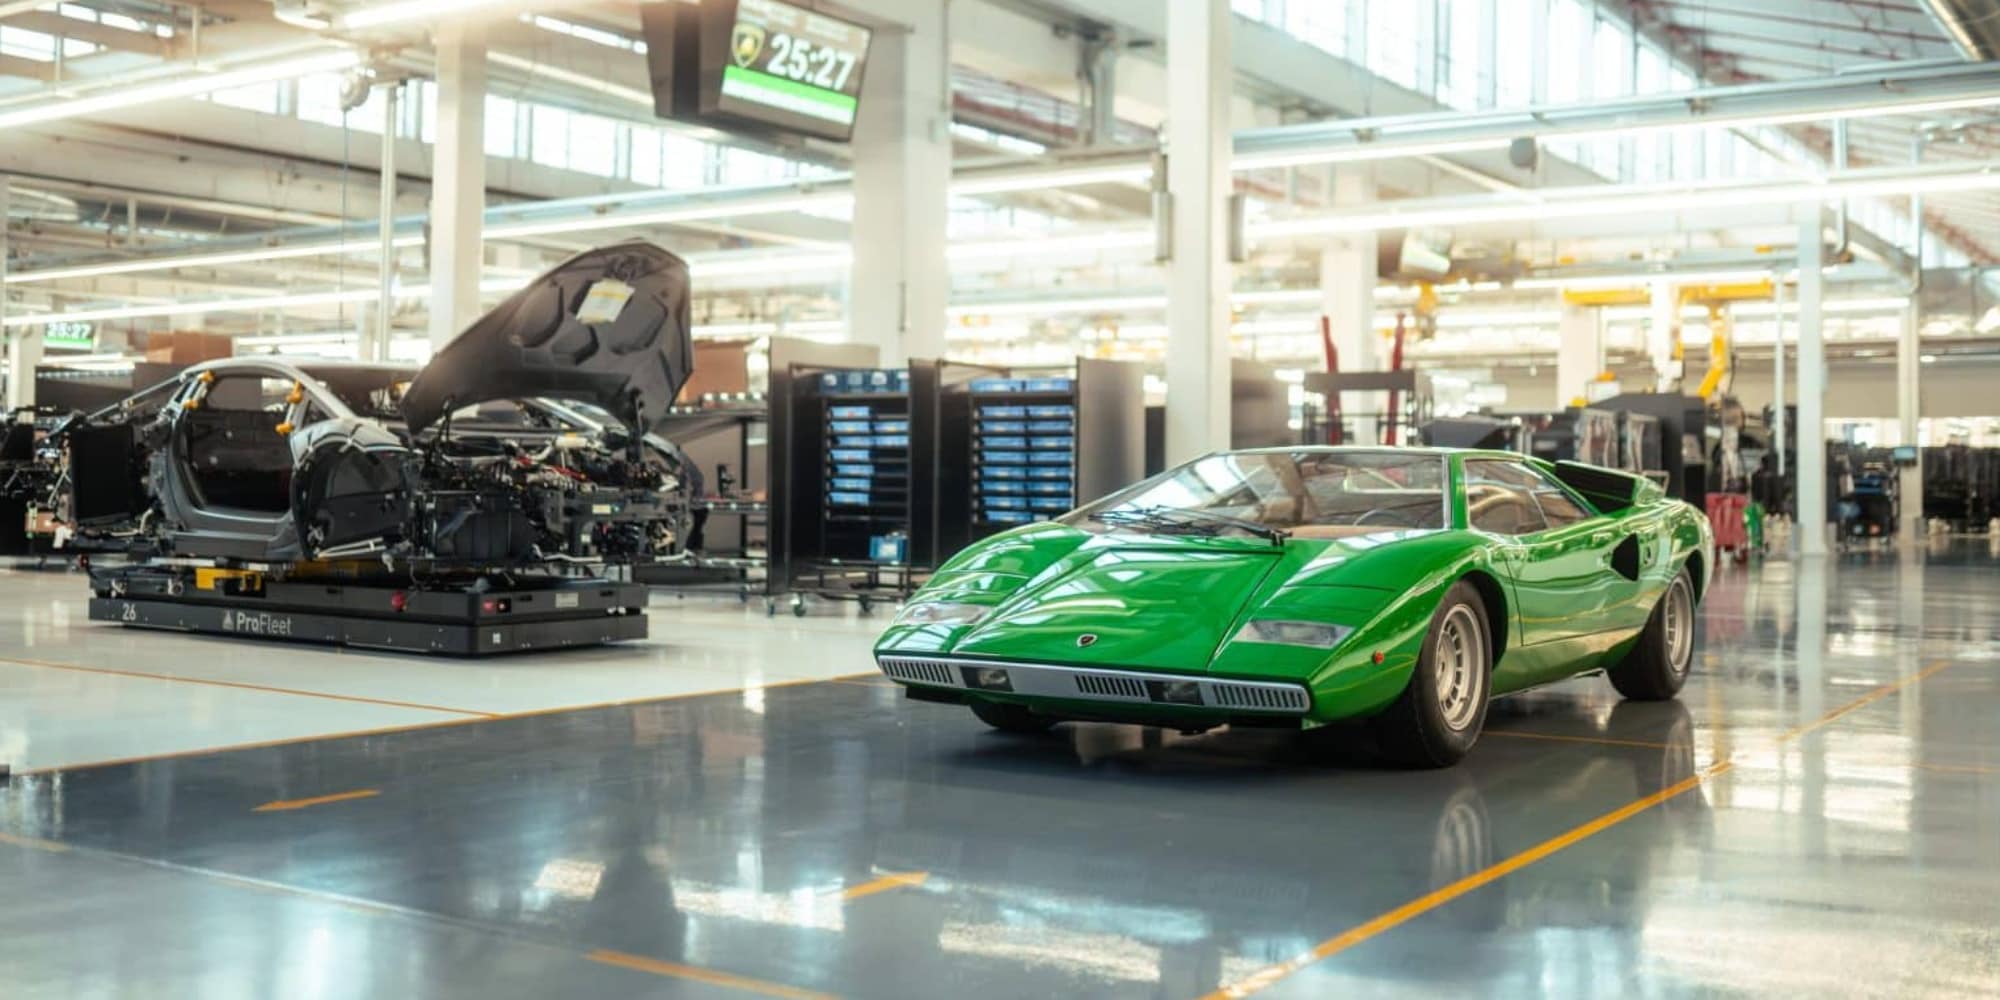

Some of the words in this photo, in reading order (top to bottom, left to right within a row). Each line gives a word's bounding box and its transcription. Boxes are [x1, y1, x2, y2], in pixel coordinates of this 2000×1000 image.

[767, 33, 856, 90] 25:27
[122, 603, 137, 621] 26
[236, 611, 292, 635] ProFleet
